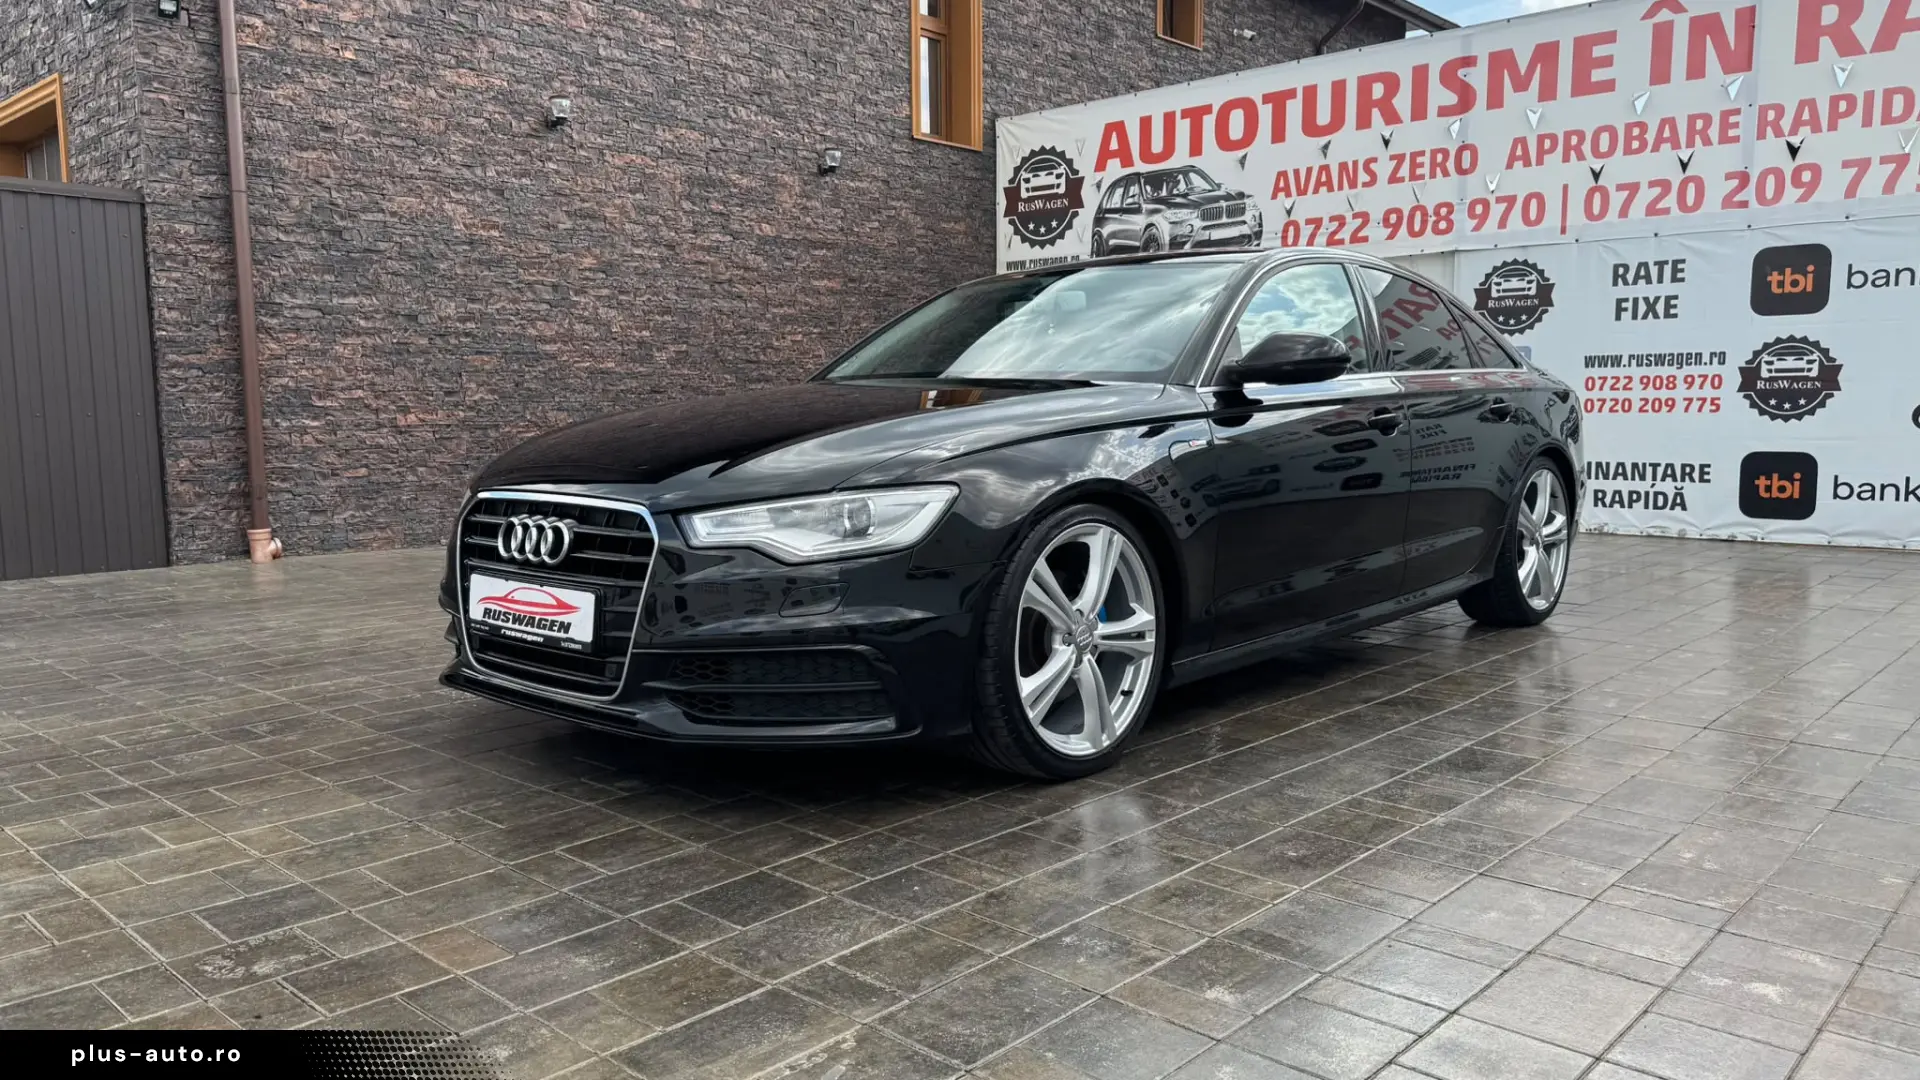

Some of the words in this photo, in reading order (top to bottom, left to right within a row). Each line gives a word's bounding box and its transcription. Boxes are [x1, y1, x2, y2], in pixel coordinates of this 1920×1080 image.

[1094, 30, 1618, 173] AUTOTURISME
[1640, 0, 1757, 87] ÎN
[1271, 156, 1378, 201] AVANS
[1387, 143, 1479, 185] ZERO
[1505, 107, 1742, 171] APROBARE
[1756, 85, 1920, 141] RAPID
[1281, 211, 1370, 247] 0722
[1382, 201, 1455, 241] 908
[1467, 191, 1546, 233] 970
[1584, 174, 1705, 223] 0720
[1721, 162, 1822, 210] 209
[1840, 152, 1920, 200] 77
[1612, 258, 1686, 287] RATE
[1767, 264, 1815, 294] tbi
[1846, 263, 1920, 290] ban
[1615, 295, 1679, 321] FIXE
[1584, 351, 1727, 370] www.ruswagen.ro
[1584, 375, 1633, 392] 0722
[1639, 374, 1677, 391] 908
[1683, 373, 1723, 391] 970
[1583, 397, 1633, 414] 0720
[1638, 397, 1677, 414] 209
[1682, 396, 1721, 414] 775
[1586, 461, 1712, 488] INANȚARE
[1755, 473, 1802, 499] tbi
[1593, 485, 1688, 511] RAPIDĂ
[482, 607, 572, 634] RUSWAGEN
